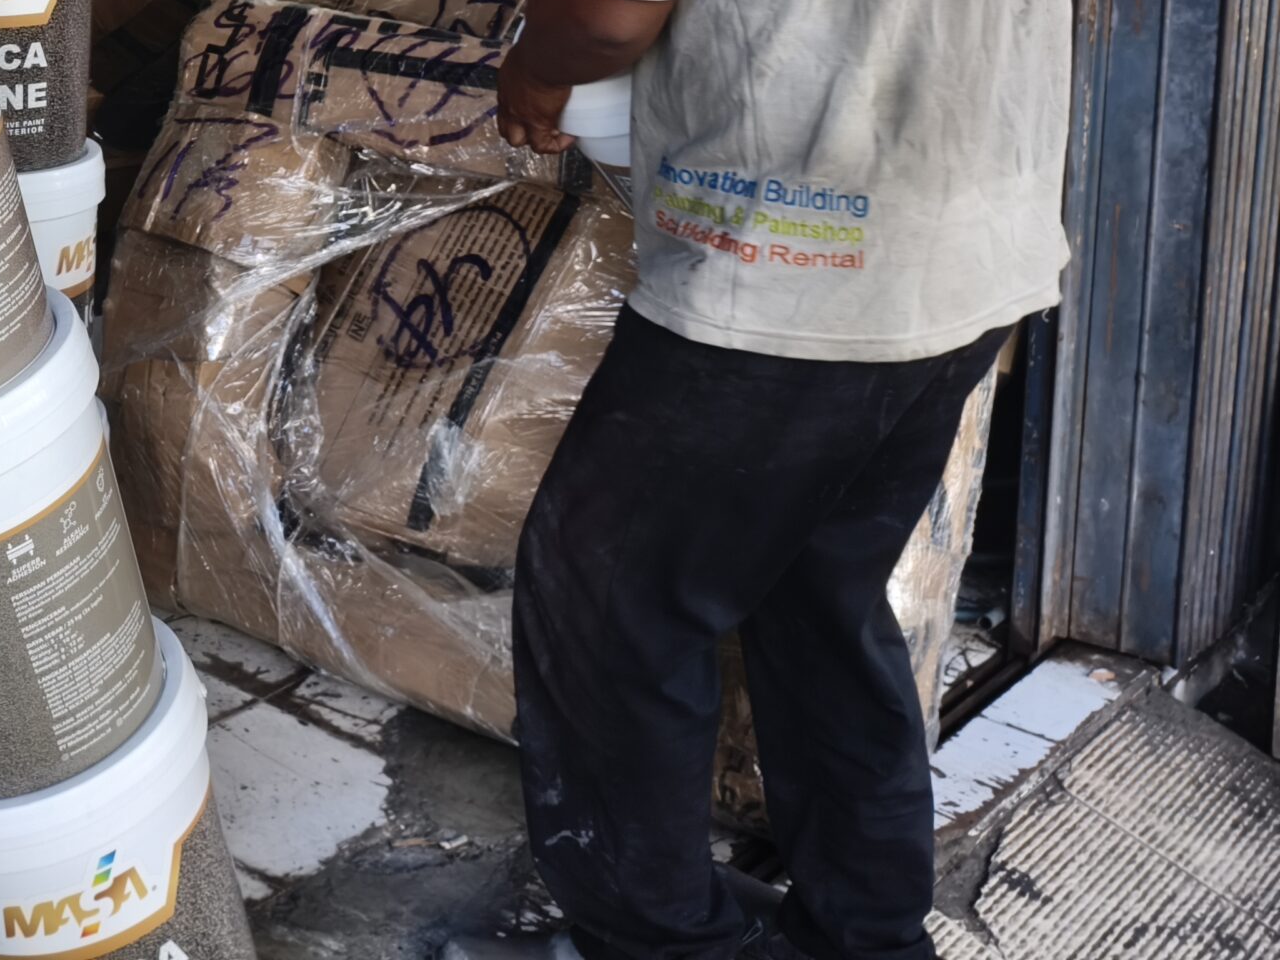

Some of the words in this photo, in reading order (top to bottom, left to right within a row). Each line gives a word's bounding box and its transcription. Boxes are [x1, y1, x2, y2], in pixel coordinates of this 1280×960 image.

[6, 121, 20, 129] IVE
[22, 118, 45, 127] PAINT
[8, 126, 44, 136] TERIOR
[764, 178, 869, 218] Building
[730, 205, 744, 225] &
[753, 210, 865, 246] Paintshop
[769, 243, 865, 270] Rental
[62, 525, 84, 545] ALKALI
[5, 559, 48, 585] ADHESION
[11, 556, 42, 576] SUPERB
[10, 580, 47, 602] PERSIAPAN
[21, 606, 67, 634] PENGENCERAN
[25, 637, 44, 649] DAYA
[44, 625, 64, 640] SEBAR
[3, 865, 149, 939] MASA
